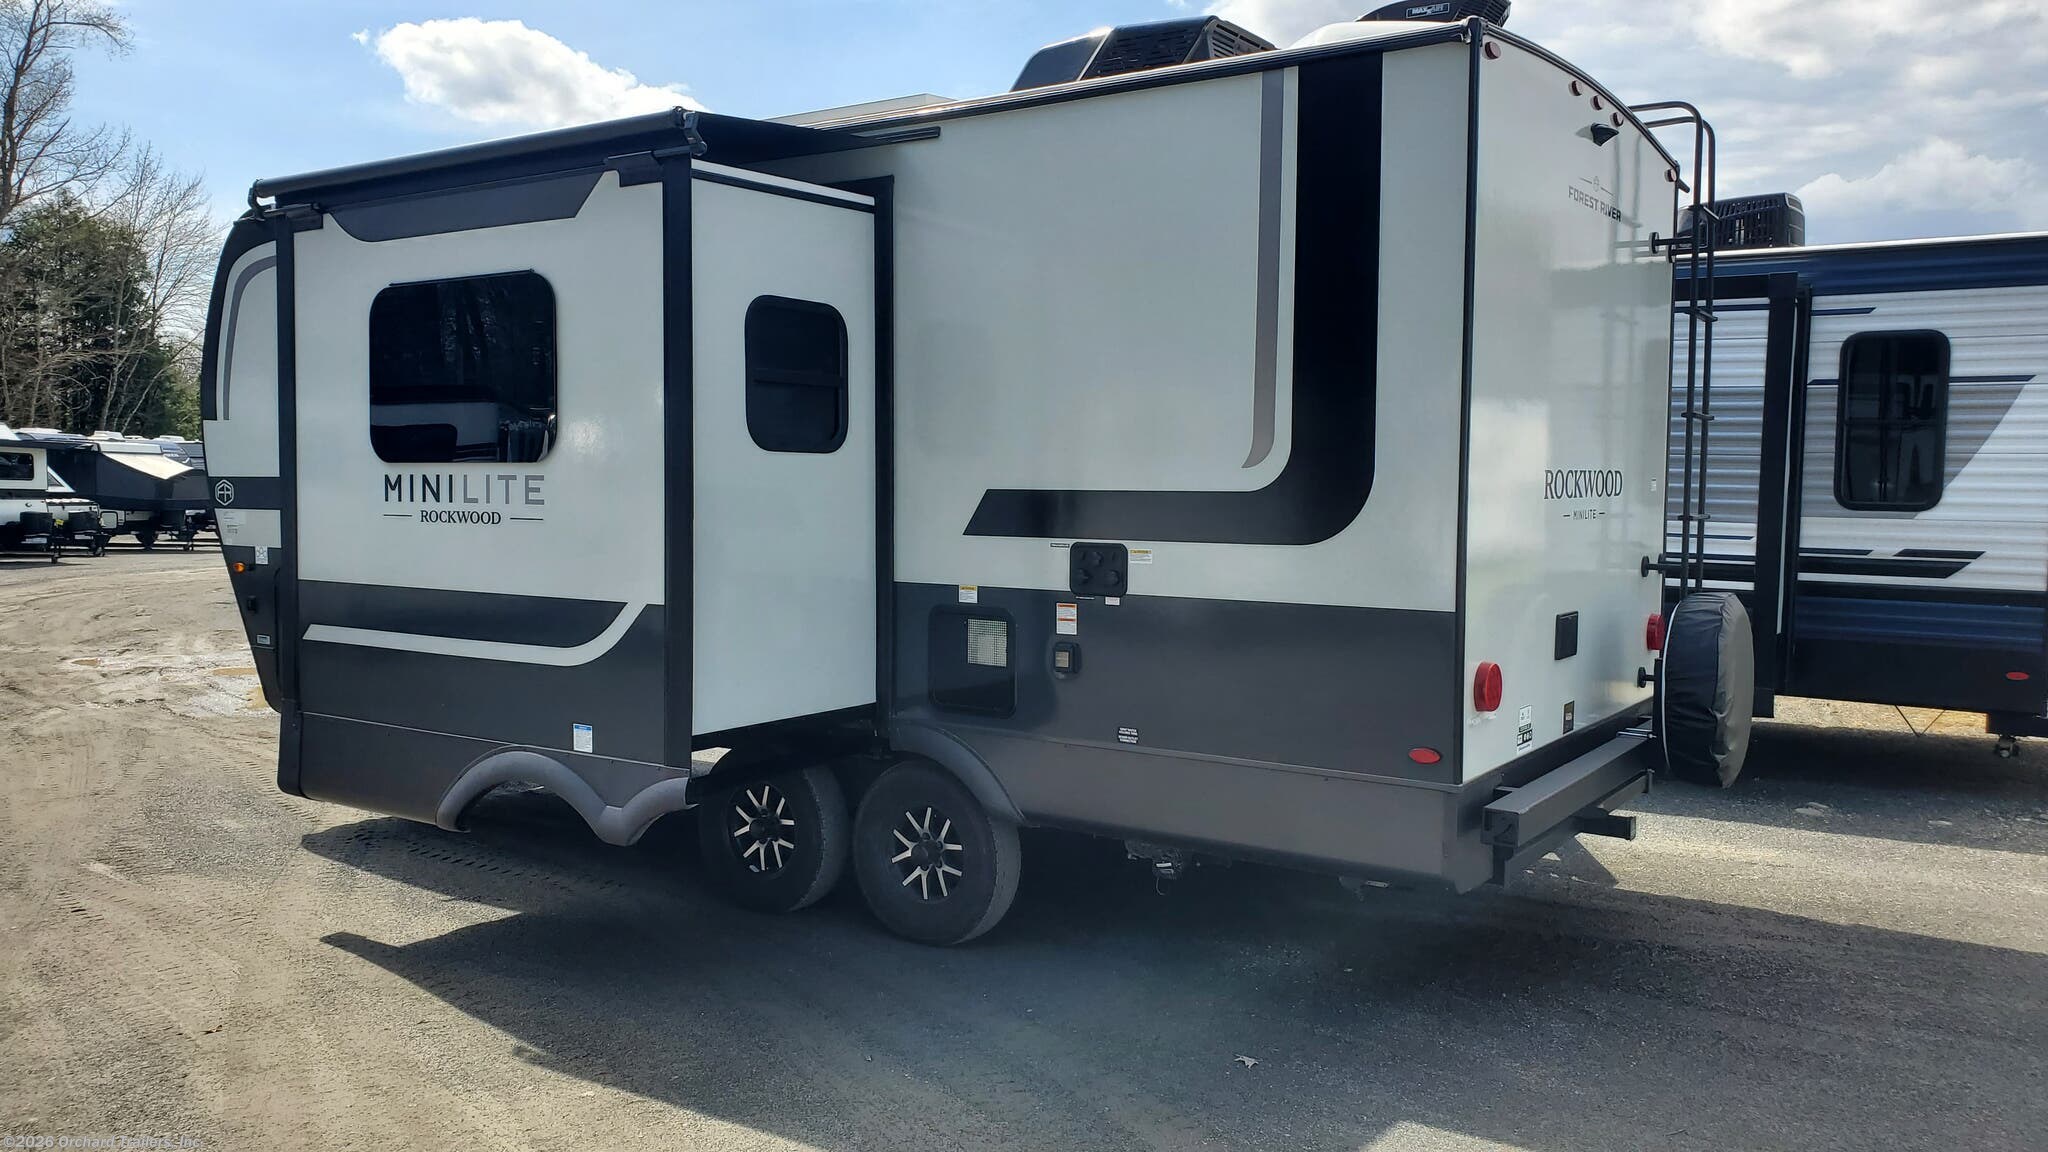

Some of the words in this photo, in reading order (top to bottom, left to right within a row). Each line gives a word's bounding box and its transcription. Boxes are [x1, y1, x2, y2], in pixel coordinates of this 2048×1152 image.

[1568, 186, 1599, 211] FOREST
[1600, 200, 1622, 222] RIVER
[384, 473, 545, 505] MINILITE
[1544, 469, 1623, 500] ROCKWOOD
[420, 510, 501, 525] ROCKWOOD
[1573, 509, 1597, 520] MINILITE
